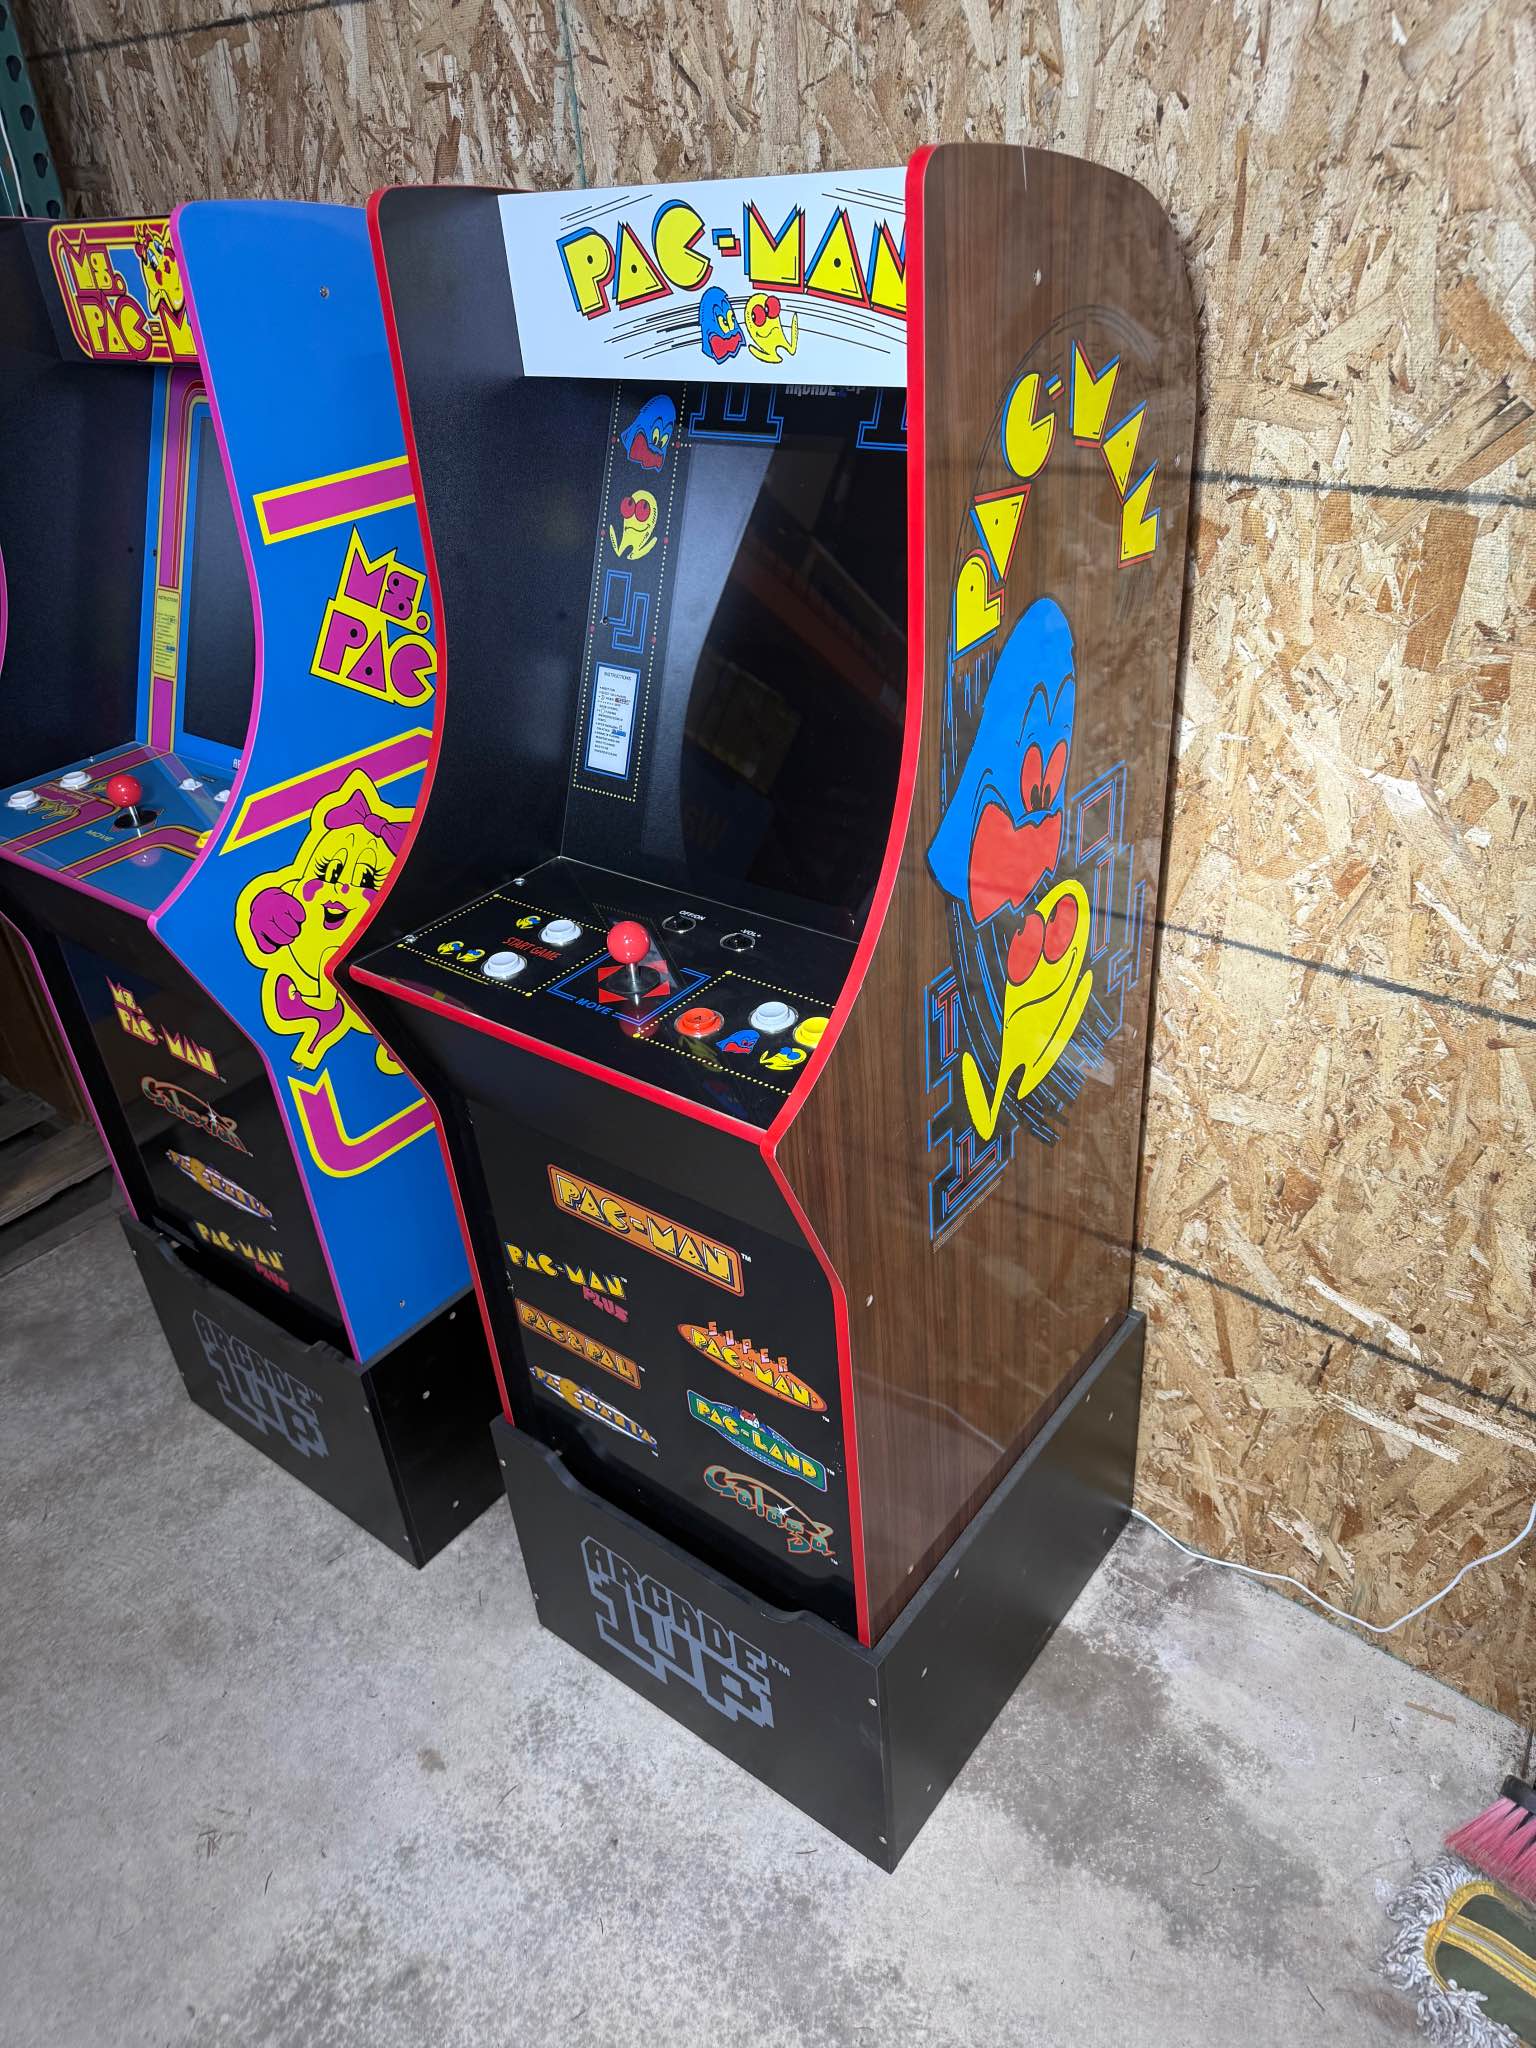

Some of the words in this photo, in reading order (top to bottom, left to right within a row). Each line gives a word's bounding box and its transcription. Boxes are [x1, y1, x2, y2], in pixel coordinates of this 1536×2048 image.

[556, 199, 906, 320] PAC-MAN
[952, 340, 1160, 662] PAC-MAN
[314, 604, 435, 703] PAC
[502, 936, 531, 951] START
[530, 944, 562, 961] GAME
[575, 997, 614, 1015] MOVE
[504, 1241, 627, 1300] PAC-MAN
[556, 1174, 736, 1288] PAC-MAN
[691, 1328, 811, 1408] PAC-MAN
[707, 1321, 789, 1373] SUPER
[696, 1399, 817, 1479] PAC-LAND
